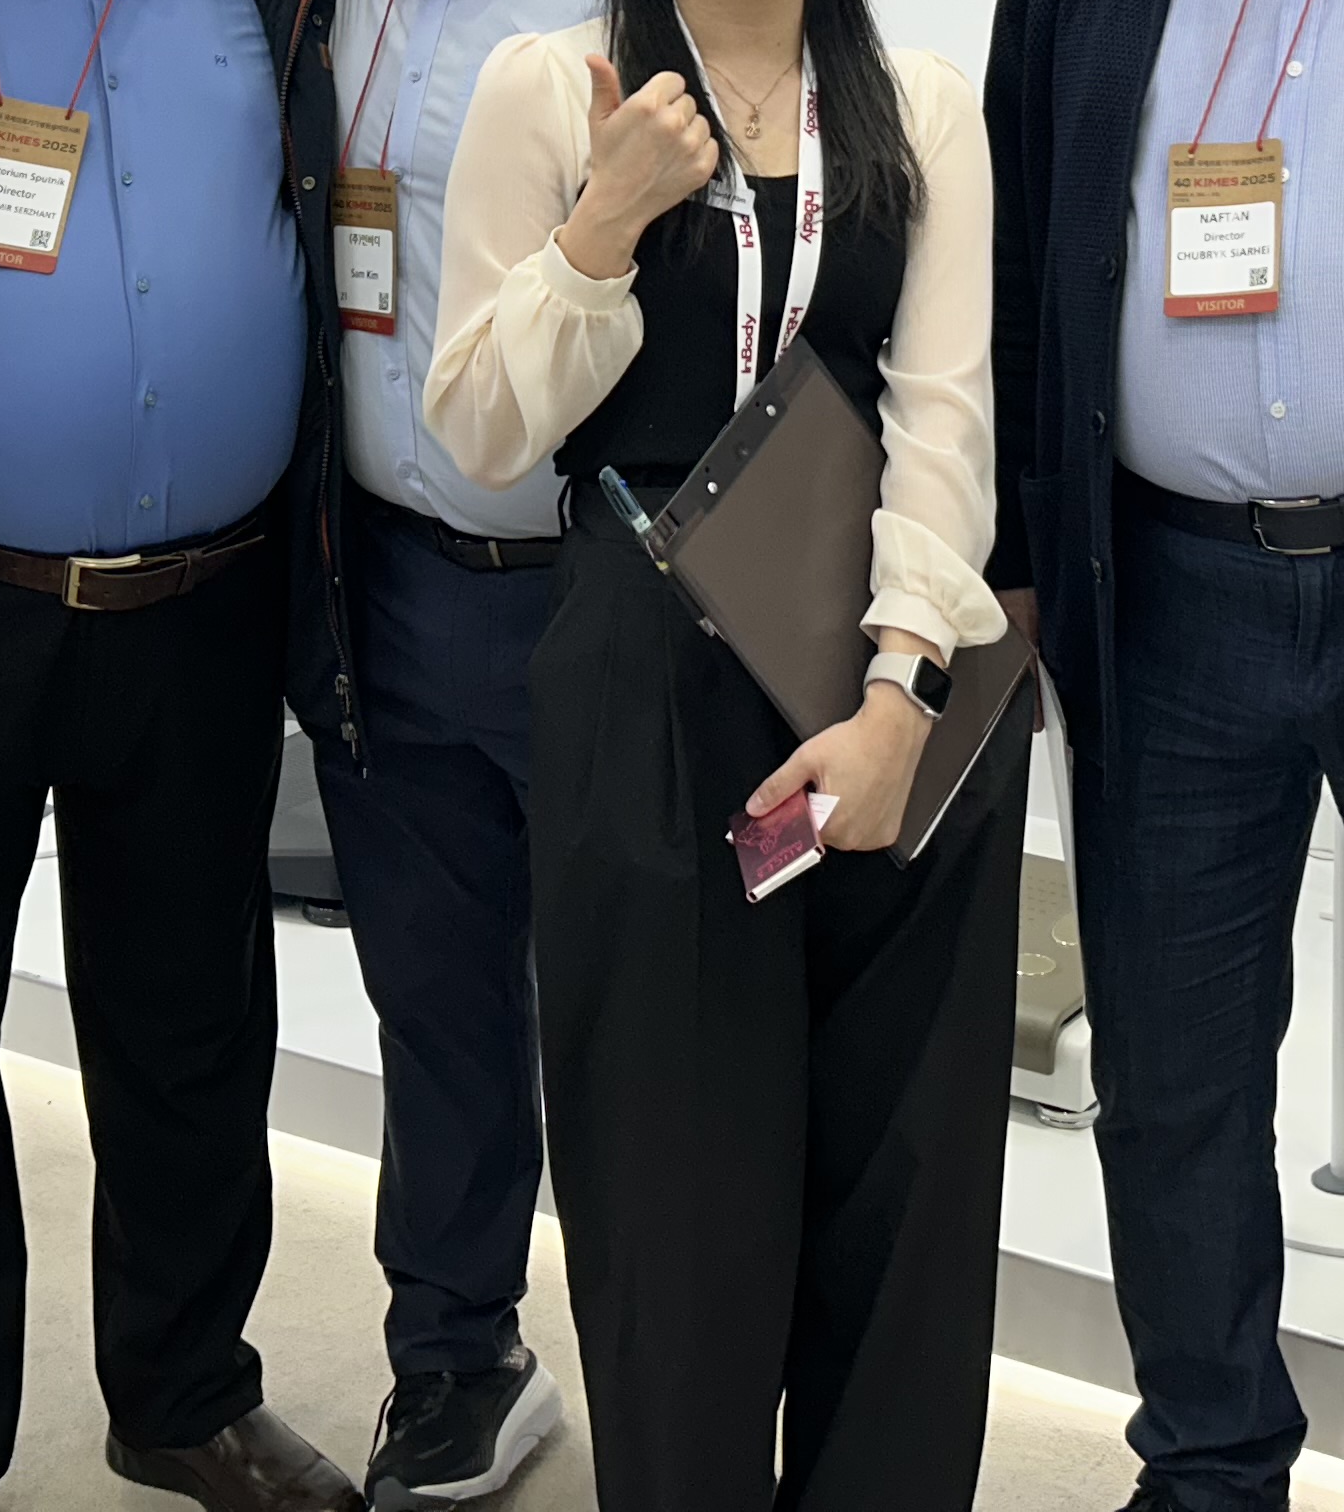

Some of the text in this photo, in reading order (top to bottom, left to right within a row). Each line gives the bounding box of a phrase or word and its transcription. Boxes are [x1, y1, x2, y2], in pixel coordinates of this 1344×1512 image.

[42, 139, 77, 154] 2025
[1193, 176, 1239, 188] KIMES
[1240, 173, 1276, 186] 2025
[799, 190, 821, 245] InBody
[1200, 210, 1250, 224] NAFTAN
[740, 215, 755, 248] InBo
[1204, 231, 1245, 243] Director
[367, 270, 379, 280] Kim
[1196, 298, 1245, 312] VISITOR
[741, 313, 757, 374] InBody
